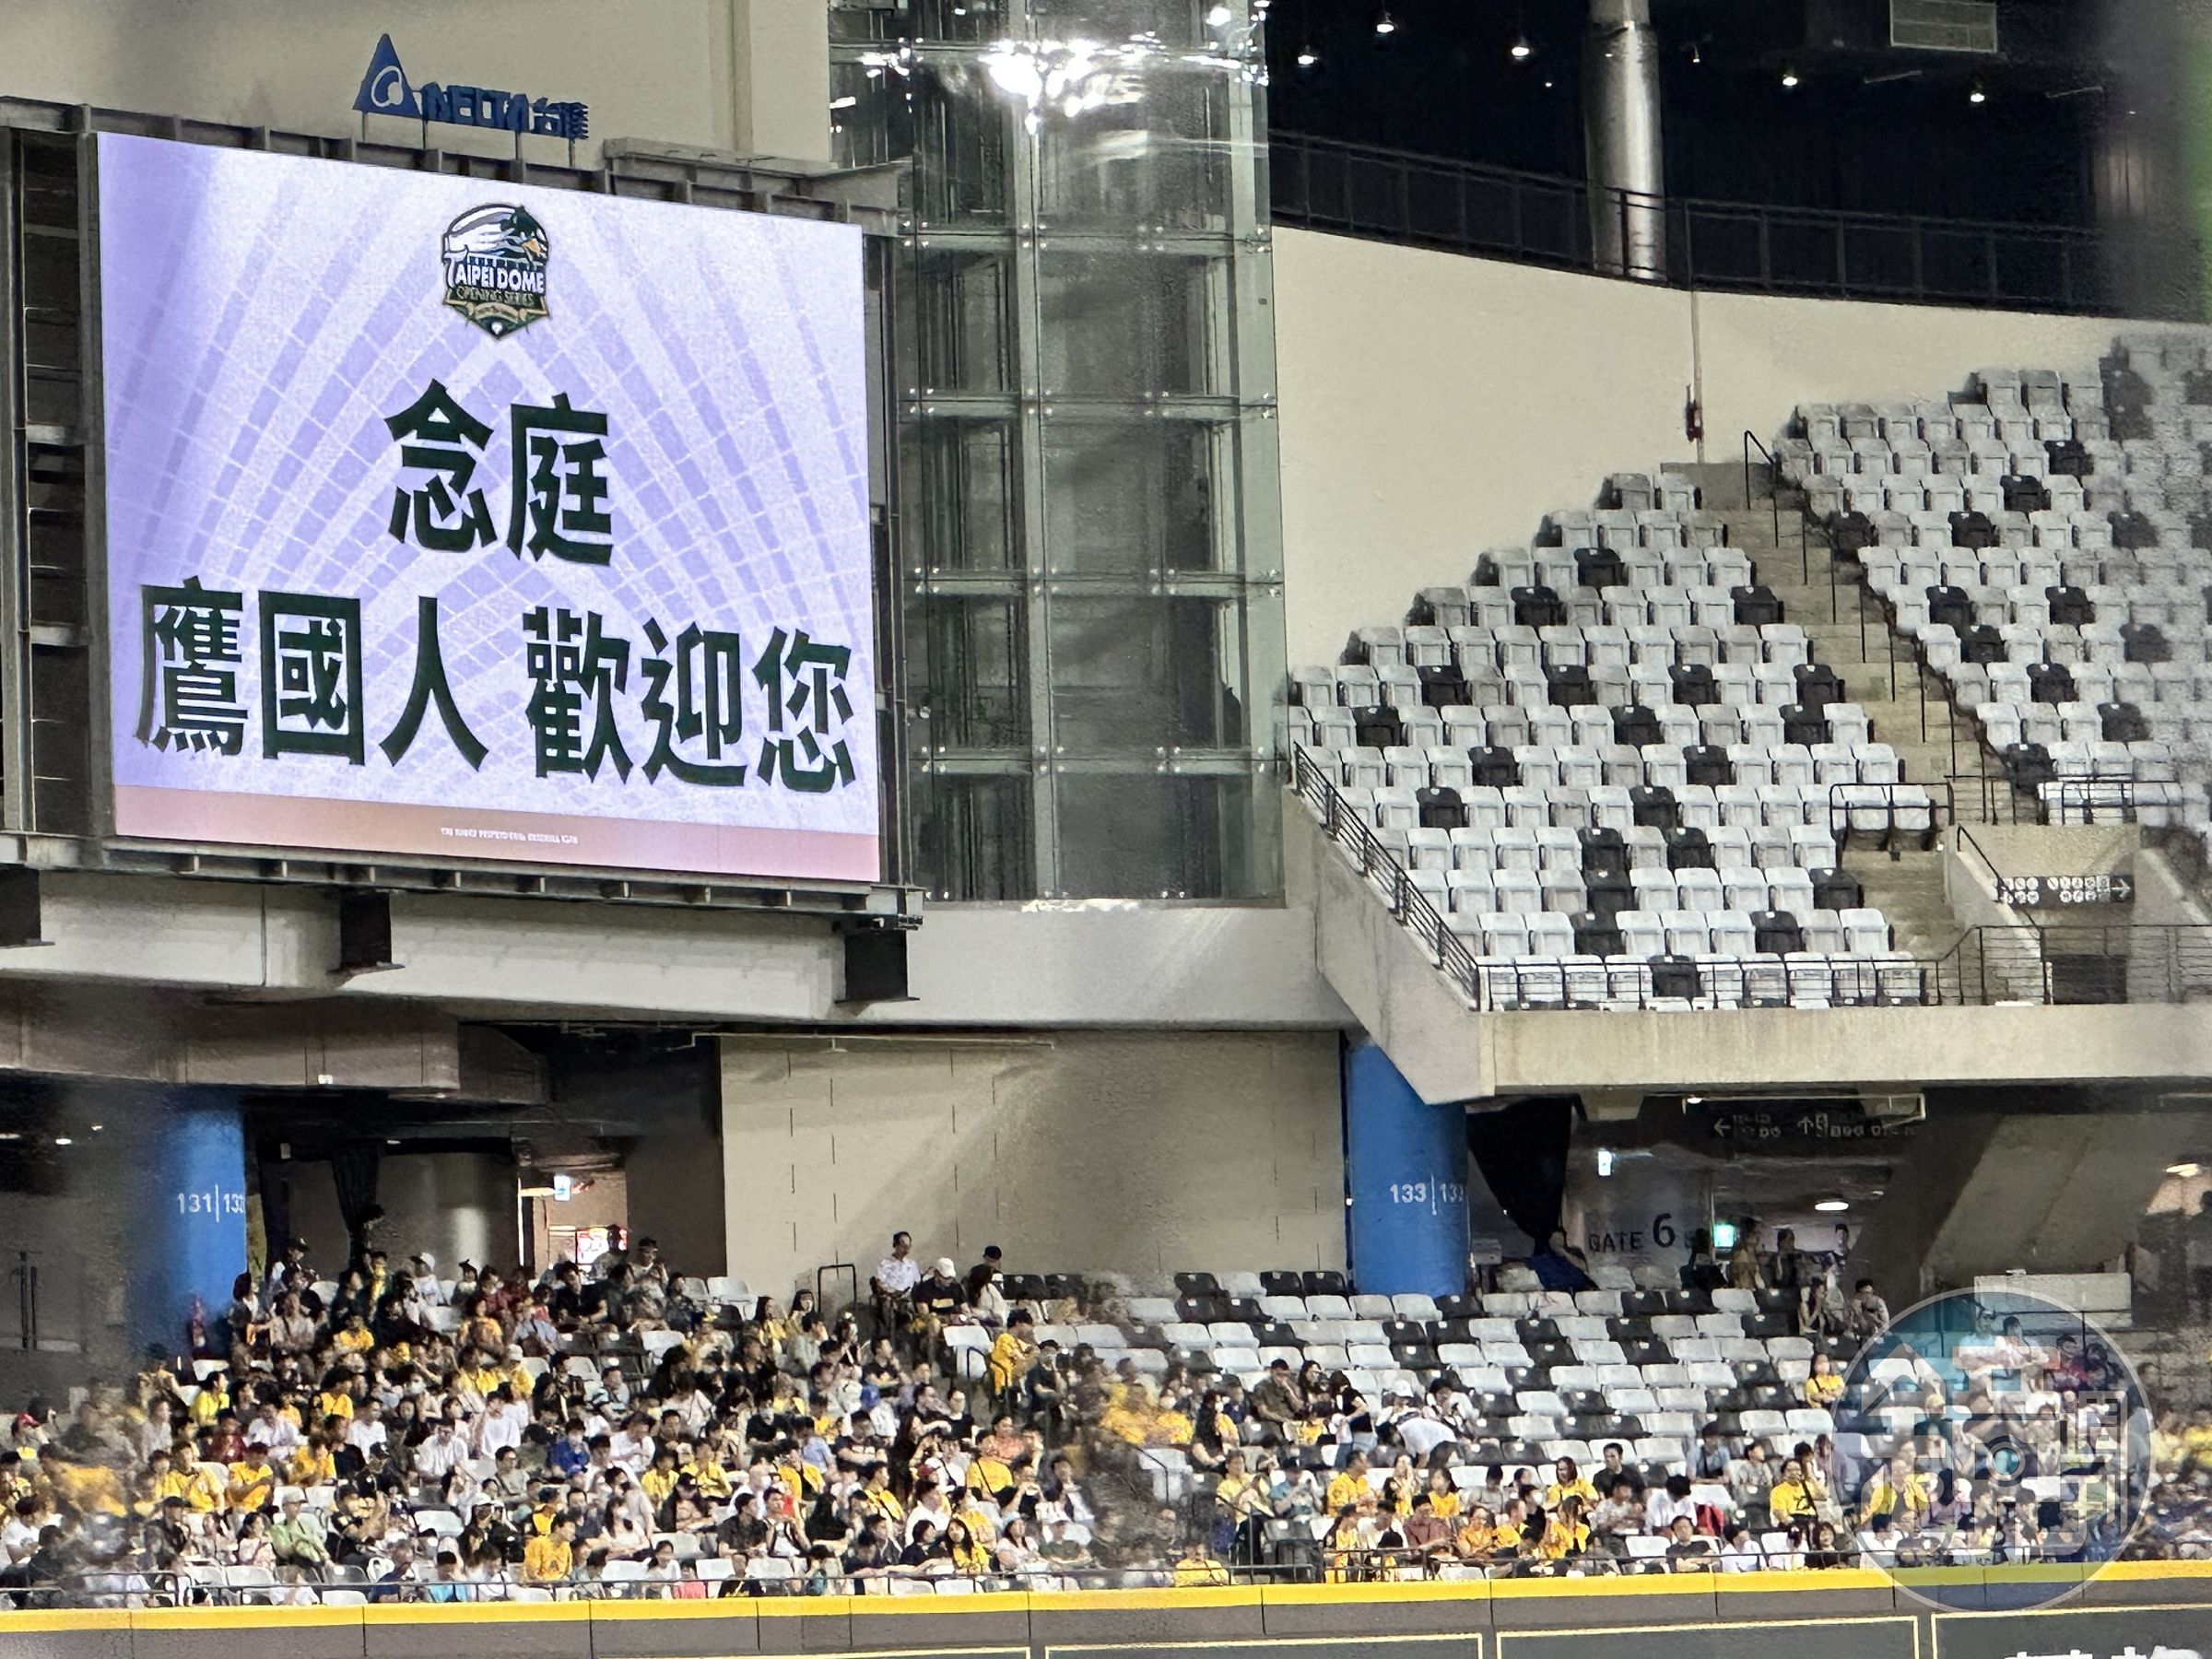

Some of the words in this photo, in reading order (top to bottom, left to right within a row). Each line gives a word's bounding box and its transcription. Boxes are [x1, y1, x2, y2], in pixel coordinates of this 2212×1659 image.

[443, 244, 495, 288] TAIPEI
[497, 267, 547, 294] DOME
[383, 378, 613, 568] 念庭
[134, 576, 489, 772] 鷹國人
[522, 606, 857, 794] 歡迎您
[1653, 1212, 1677, 1249] 6
